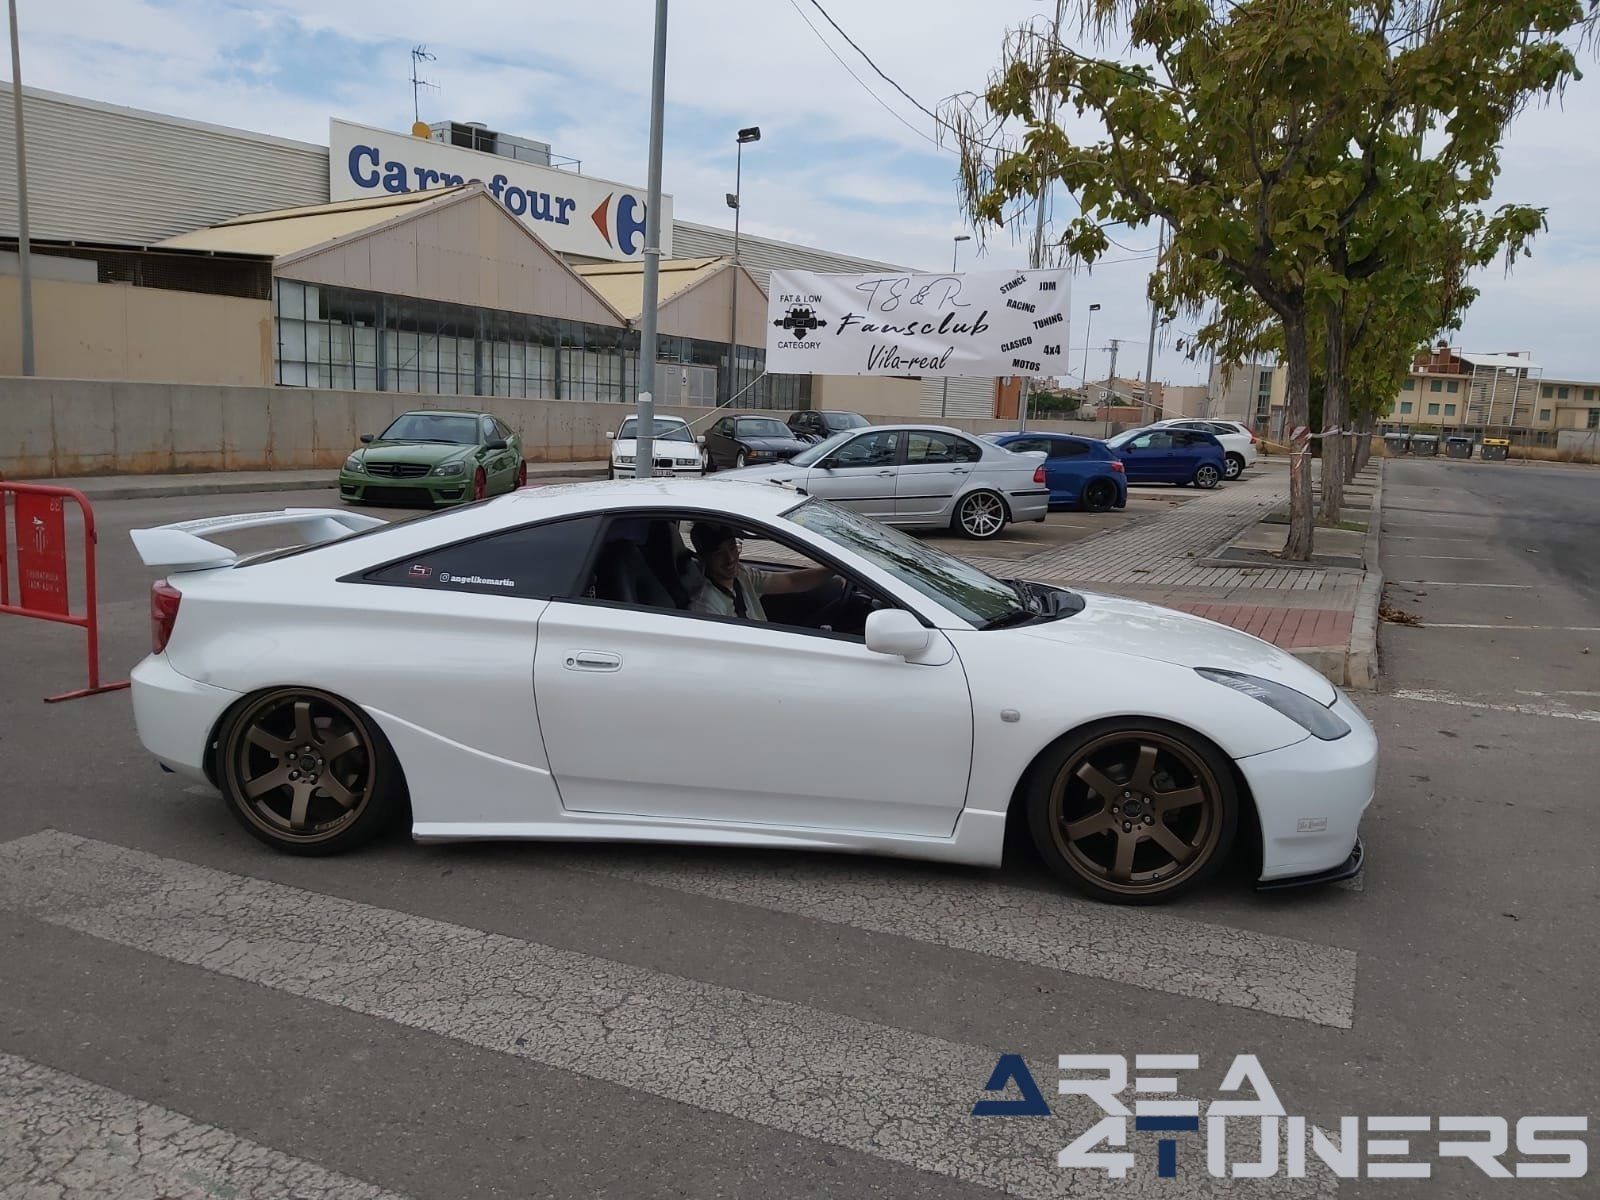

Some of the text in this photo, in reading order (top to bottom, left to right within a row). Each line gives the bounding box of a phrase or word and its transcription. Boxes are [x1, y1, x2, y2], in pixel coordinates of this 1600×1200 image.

[1000, 274, 1027, 295] STANCE
[1039, 280, 1057, 292] JDM
[779, 294, 822, 304] FAT & LOW
[909, 285, 930, 305] &
[1006, 298, 1036, 314] RACING
[836, 310, 990, 336] Fansclub
[1033, 312, 1063, 331] TUNING
[777, 340, 821, 350] CATEGORY
[1001, 336, 1033, 353] CLASICO
[1043, 344, 1061, 356] 4x4
[867, 344, 954, 370] Vila-real
[1012, 358, 1040, 372] MOTOS
